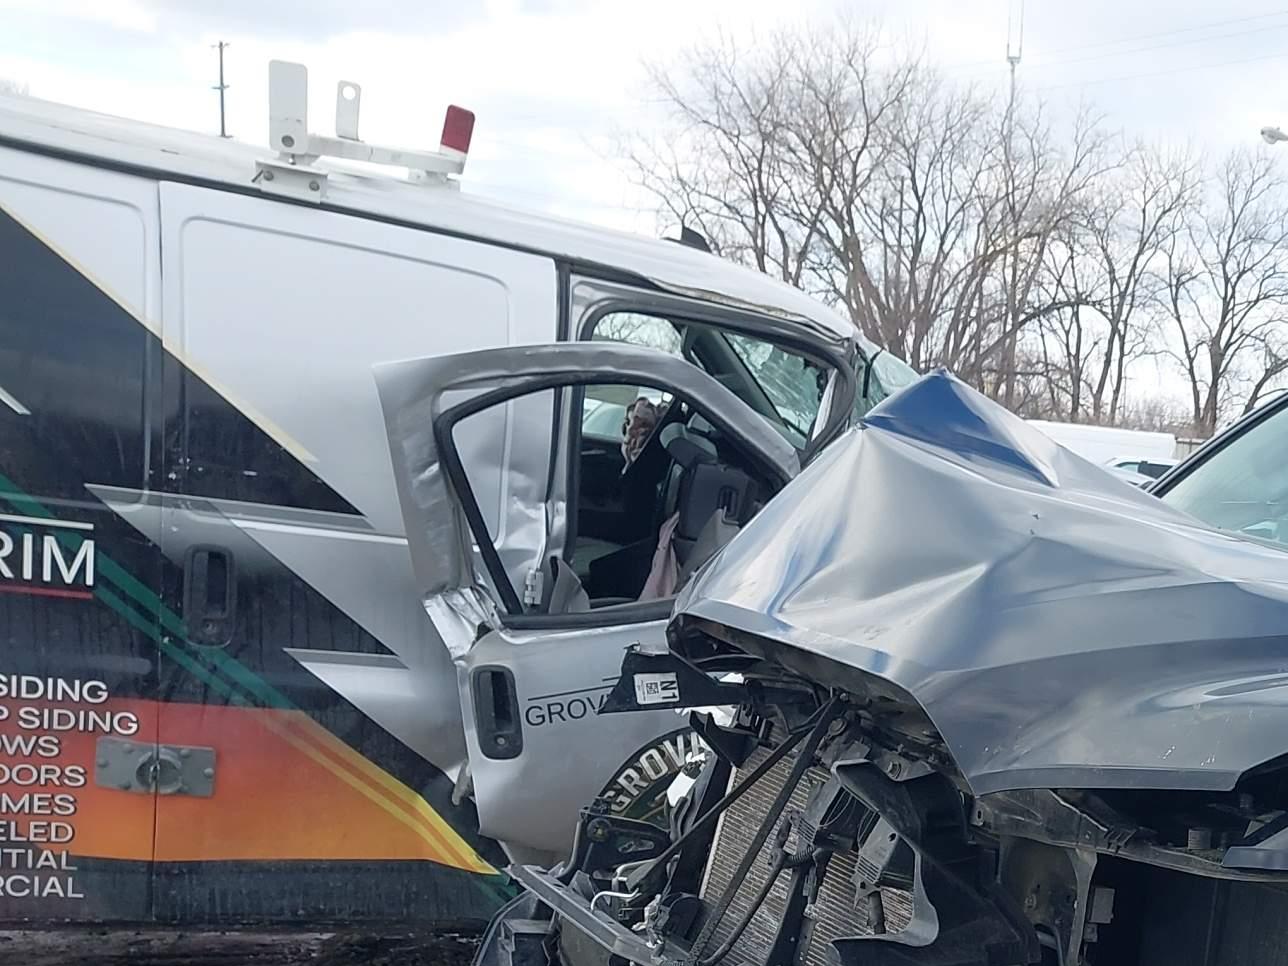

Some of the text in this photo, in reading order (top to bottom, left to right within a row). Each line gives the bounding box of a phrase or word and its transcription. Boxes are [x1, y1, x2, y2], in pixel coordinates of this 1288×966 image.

[18, 707, 138, 735] SIDING
[525, 693, 609, 726] GROV
[0, 734, 59, 757] WS
[0, 847, 78, 870] TIAL
[0, 874, 84, 898] CIAL
